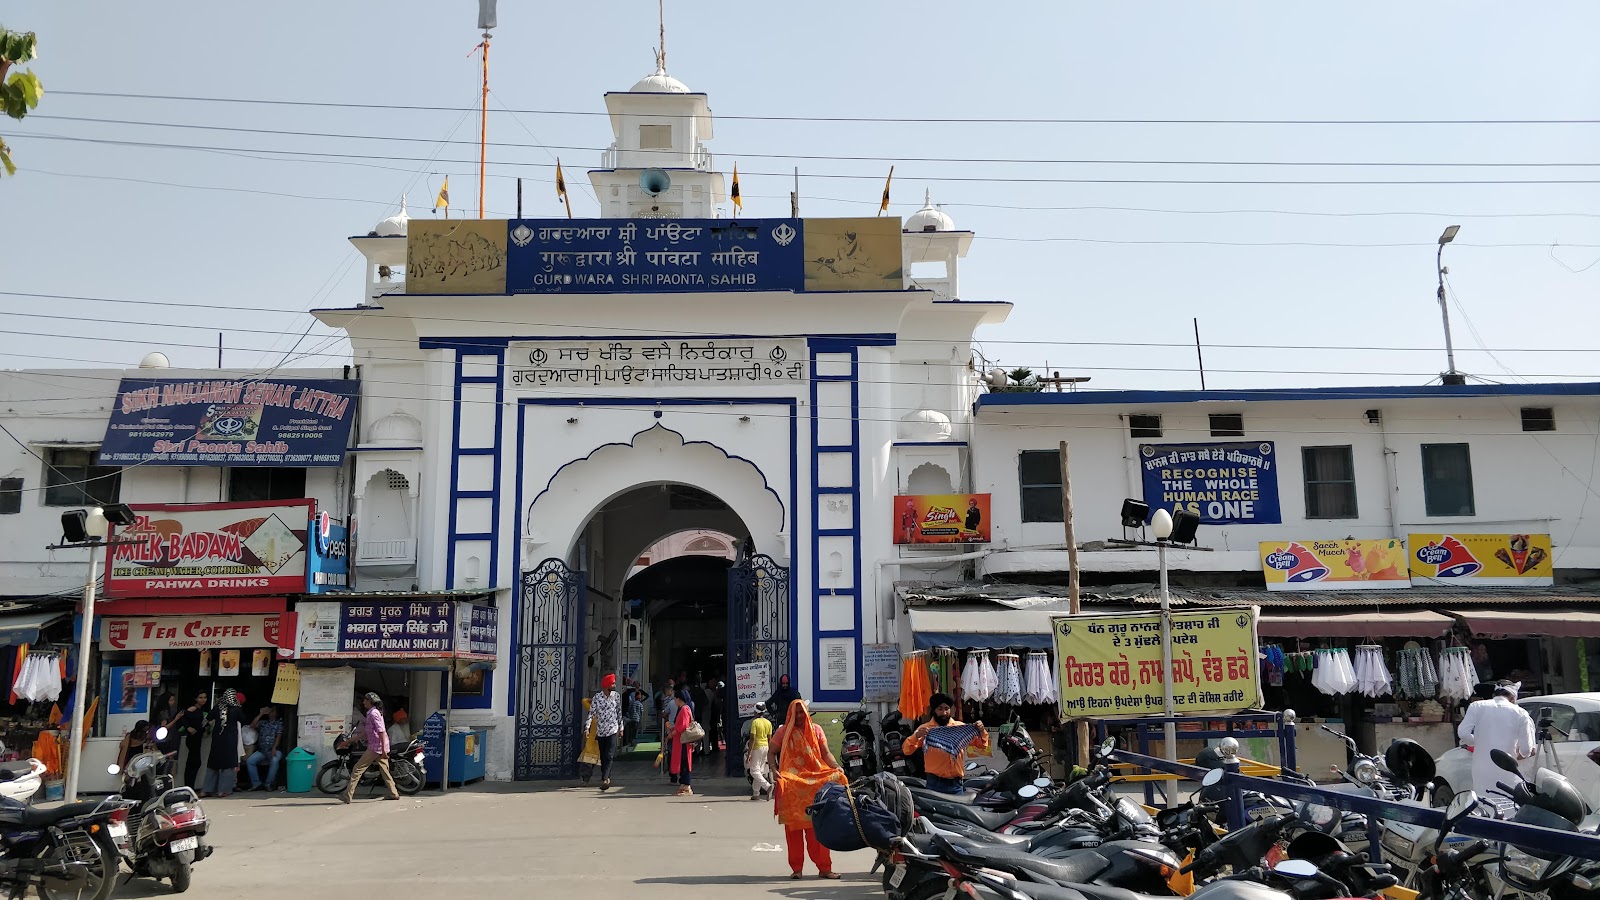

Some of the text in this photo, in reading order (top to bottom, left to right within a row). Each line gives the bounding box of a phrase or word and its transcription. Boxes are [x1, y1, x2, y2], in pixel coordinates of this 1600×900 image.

[539, 227, 612, 244] ਗੁਰਦੁਆਰਾ
[616, 246, 637, 266] श्री
[645, 247, 701, 266] पांवटा
[711, 246, 759, 267] साहिब
[622, 274, 653, 285] SHRI
[656, 274, 705, 285] PAONTA
[711, 274, 757, 285] SAHIB
[599, 342, 632, 361] ਖੰਡਿ
[641, 341, 671, 360] ਵਸੈ
[512, 369, 583, 386] ਗੁਰਦੁਆਰਾ
[652, 363, 696, 381] ਸਾਹਿਬ
[122, 380, 350, 420] SIKH NAUJAWAN SEWAK JATTHA
[153, 440, 288, 454] Shri Paonta Sahib
[1168, 451, 1180, 464] ਕੀ
[1162, 468, 1257, 479] RECOGNISE
[1162, 480, 1258, 490] THE WHOLE
[1163, 490, 1259, 502] HUMAN RACE
[927, 509, 955, 523] Singh
[1207, 501, 1255, 519] ONE
[115, 531, 242, 562] MILK BADAM
[329, 539, 347, 559] pepsi
[1313, 541, 1339, 550] Sacch
[1418, 547, 1447, 557] Cream
[1269, 554, 1295, 564] Cream
[1425, 553, 1443, 562] Bell
[1276, 560, 1290, 570] Bell
[113, 568, 131, 576] ICE
[146, 579, 269, 588] PAHWA DRINKS
[348, 606, 374, 617] ਭਗਤ
[409, 603, 431, 616] ਸਿੰਘ
[437, 603, 449, 616] ਜੀ
[142, 620, 250, 639] TEA COFFEE
[347, 620, 448, 637] भगत पूरन सिंह जी
[1088, 623, 1105, 633] ਧੰਨ
[1130, 622, 1161, 632] ਨਾਨਕ
[1207, 617, 1219, 629] ਜੀ
[345, 639, 448, 650] BHAGAT PURAN SINGH JI
[1112, 636, 1120, 647] ਦੇ
[1065, 655, 1105, 687] ਕਿਰਤ
[1202, 649, 1223, 682] ਵੰਡ
[1187, 692, 1197, 704] ਦੀ
